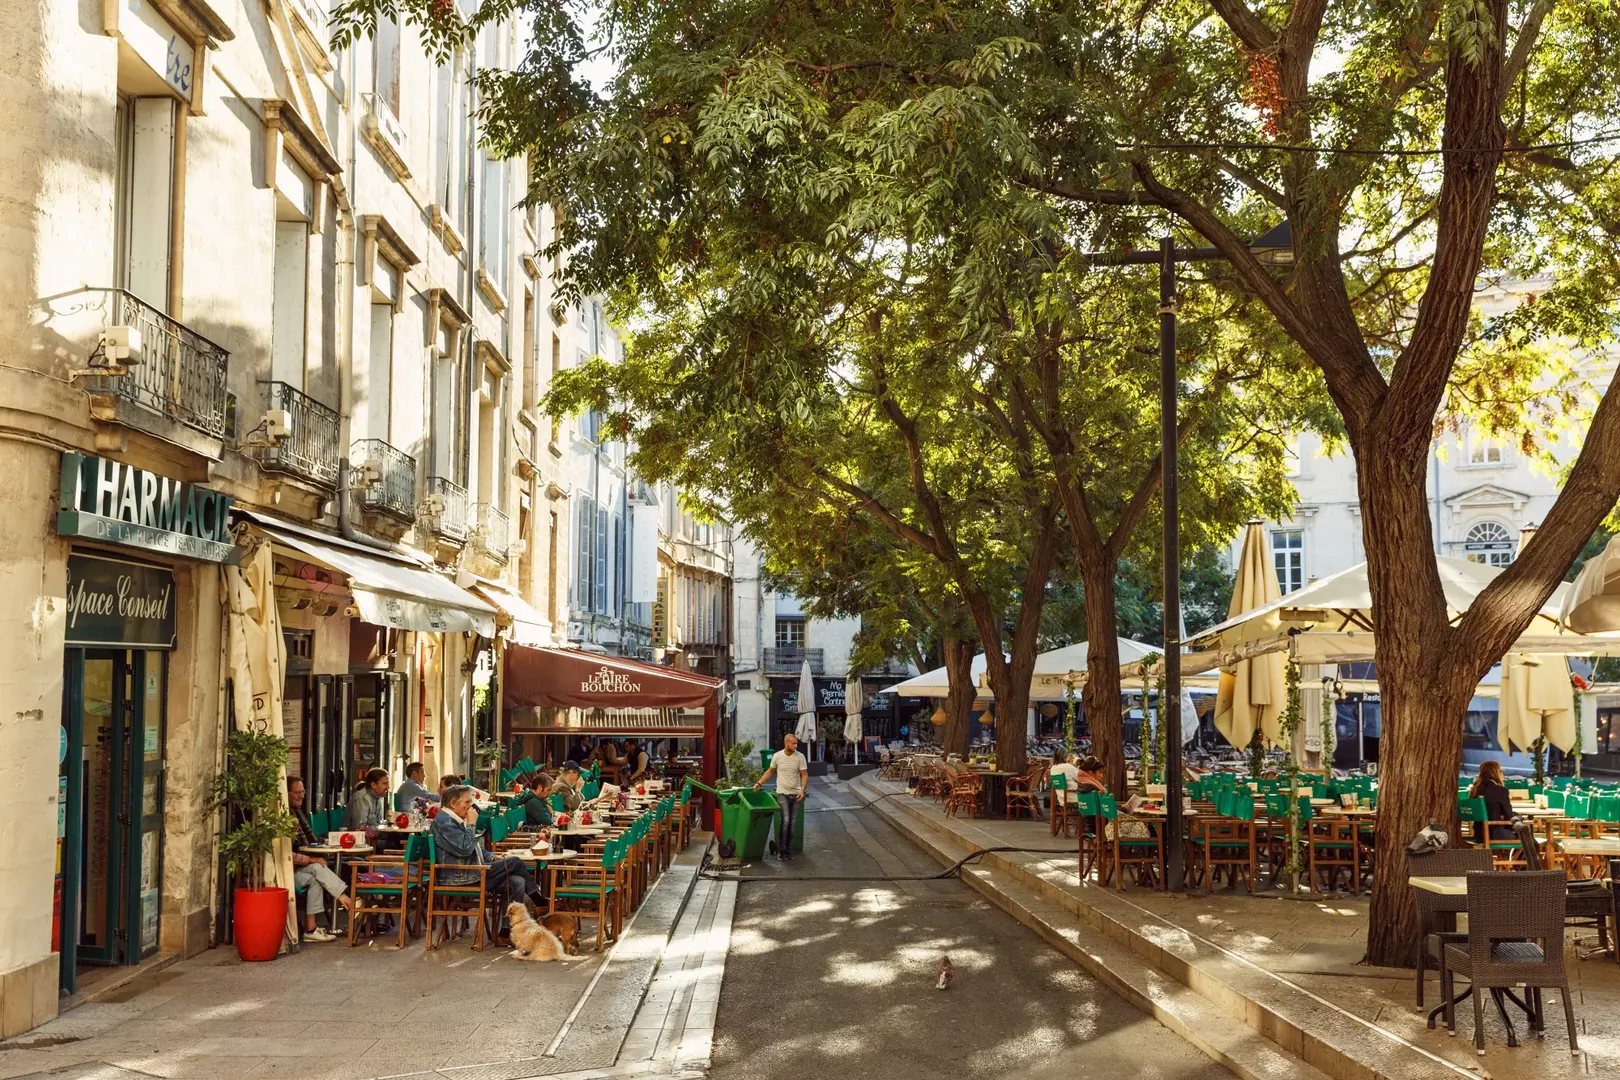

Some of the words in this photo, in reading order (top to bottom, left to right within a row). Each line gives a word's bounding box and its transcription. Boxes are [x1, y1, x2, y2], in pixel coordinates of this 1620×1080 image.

[97, 520, 112, 537] DE
[118, 524, 132, 541] LA
[136, 529, 169, 548] PLACE
[66, 567, 113, 628] space
[116, 575, 170, 619] Conseil
[581, 682, 641, 692] BOUCHON
[1041, 677, 1051, 685] Le
